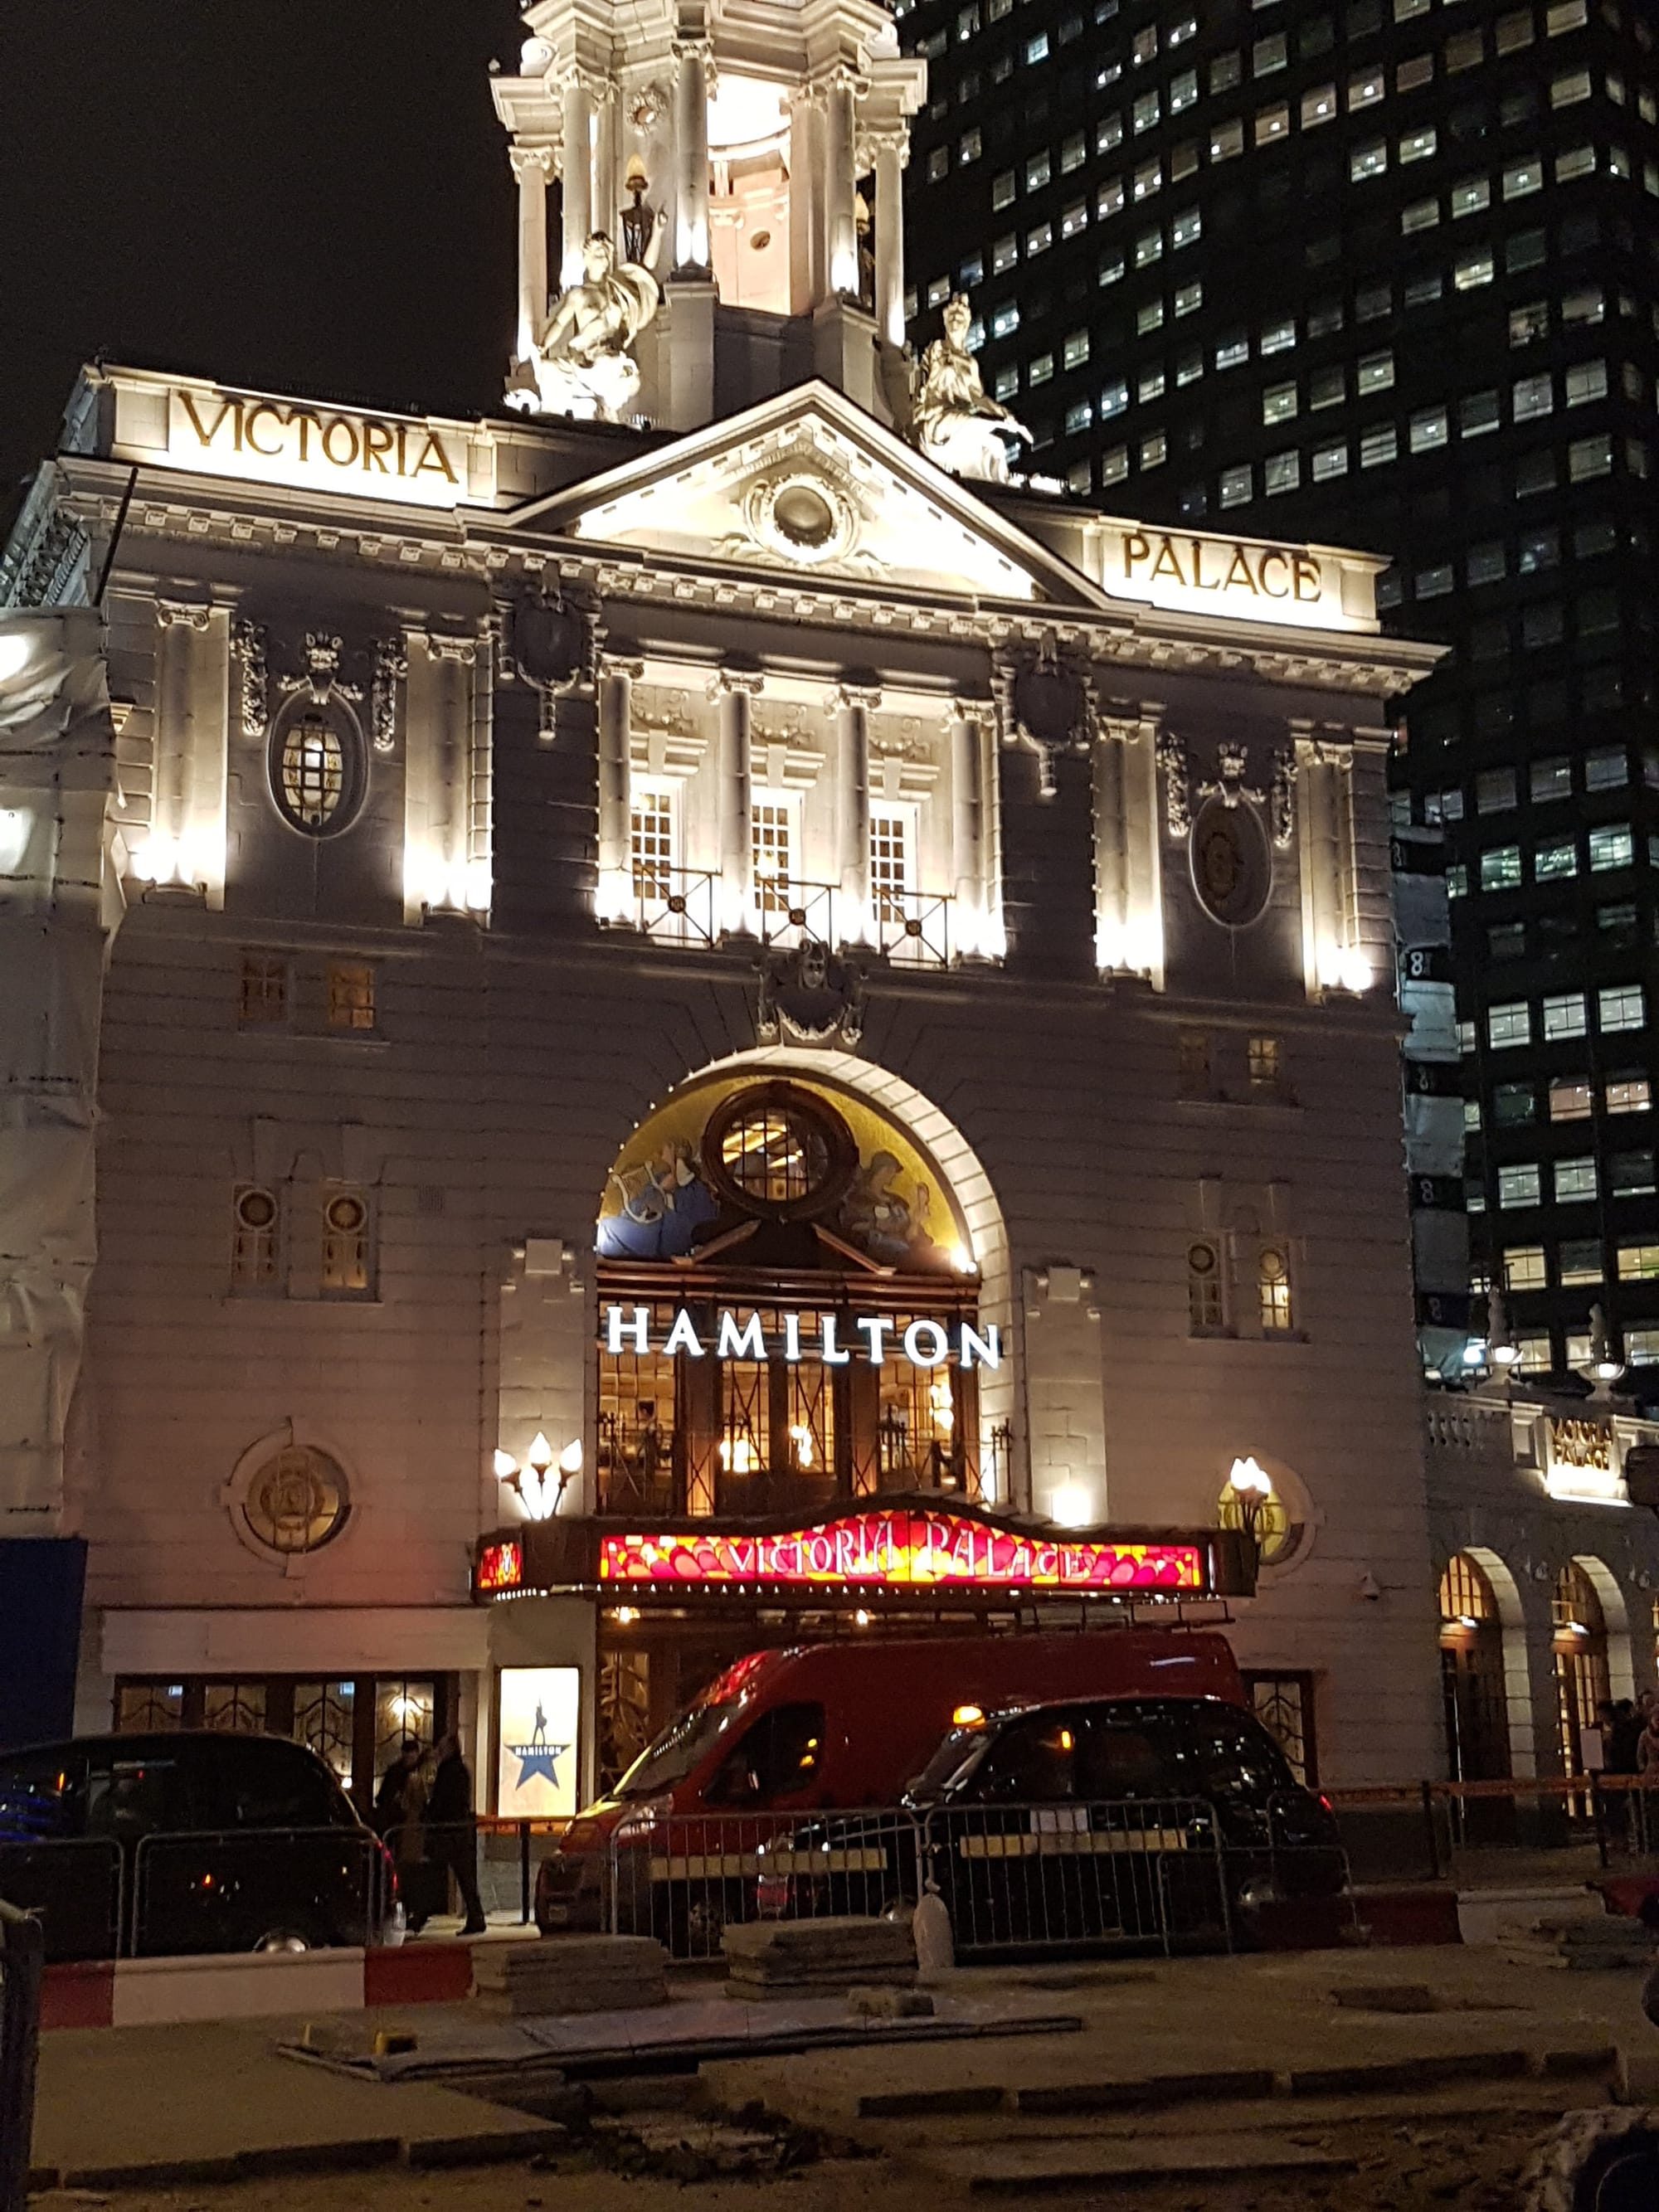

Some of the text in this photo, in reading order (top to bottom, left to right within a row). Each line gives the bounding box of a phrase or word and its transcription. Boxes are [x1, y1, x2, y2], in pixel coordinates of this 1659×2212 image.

[178, 391, 459, 484] VICTORIA
[1122, 534, 1321, 602] PALACE
[606, 1305, 999, 1369] HAMILTON
[730, 1520, 1084, 1578] VICTORIA PALACE
[515, 1745, 562, 1756] HAMILTON
